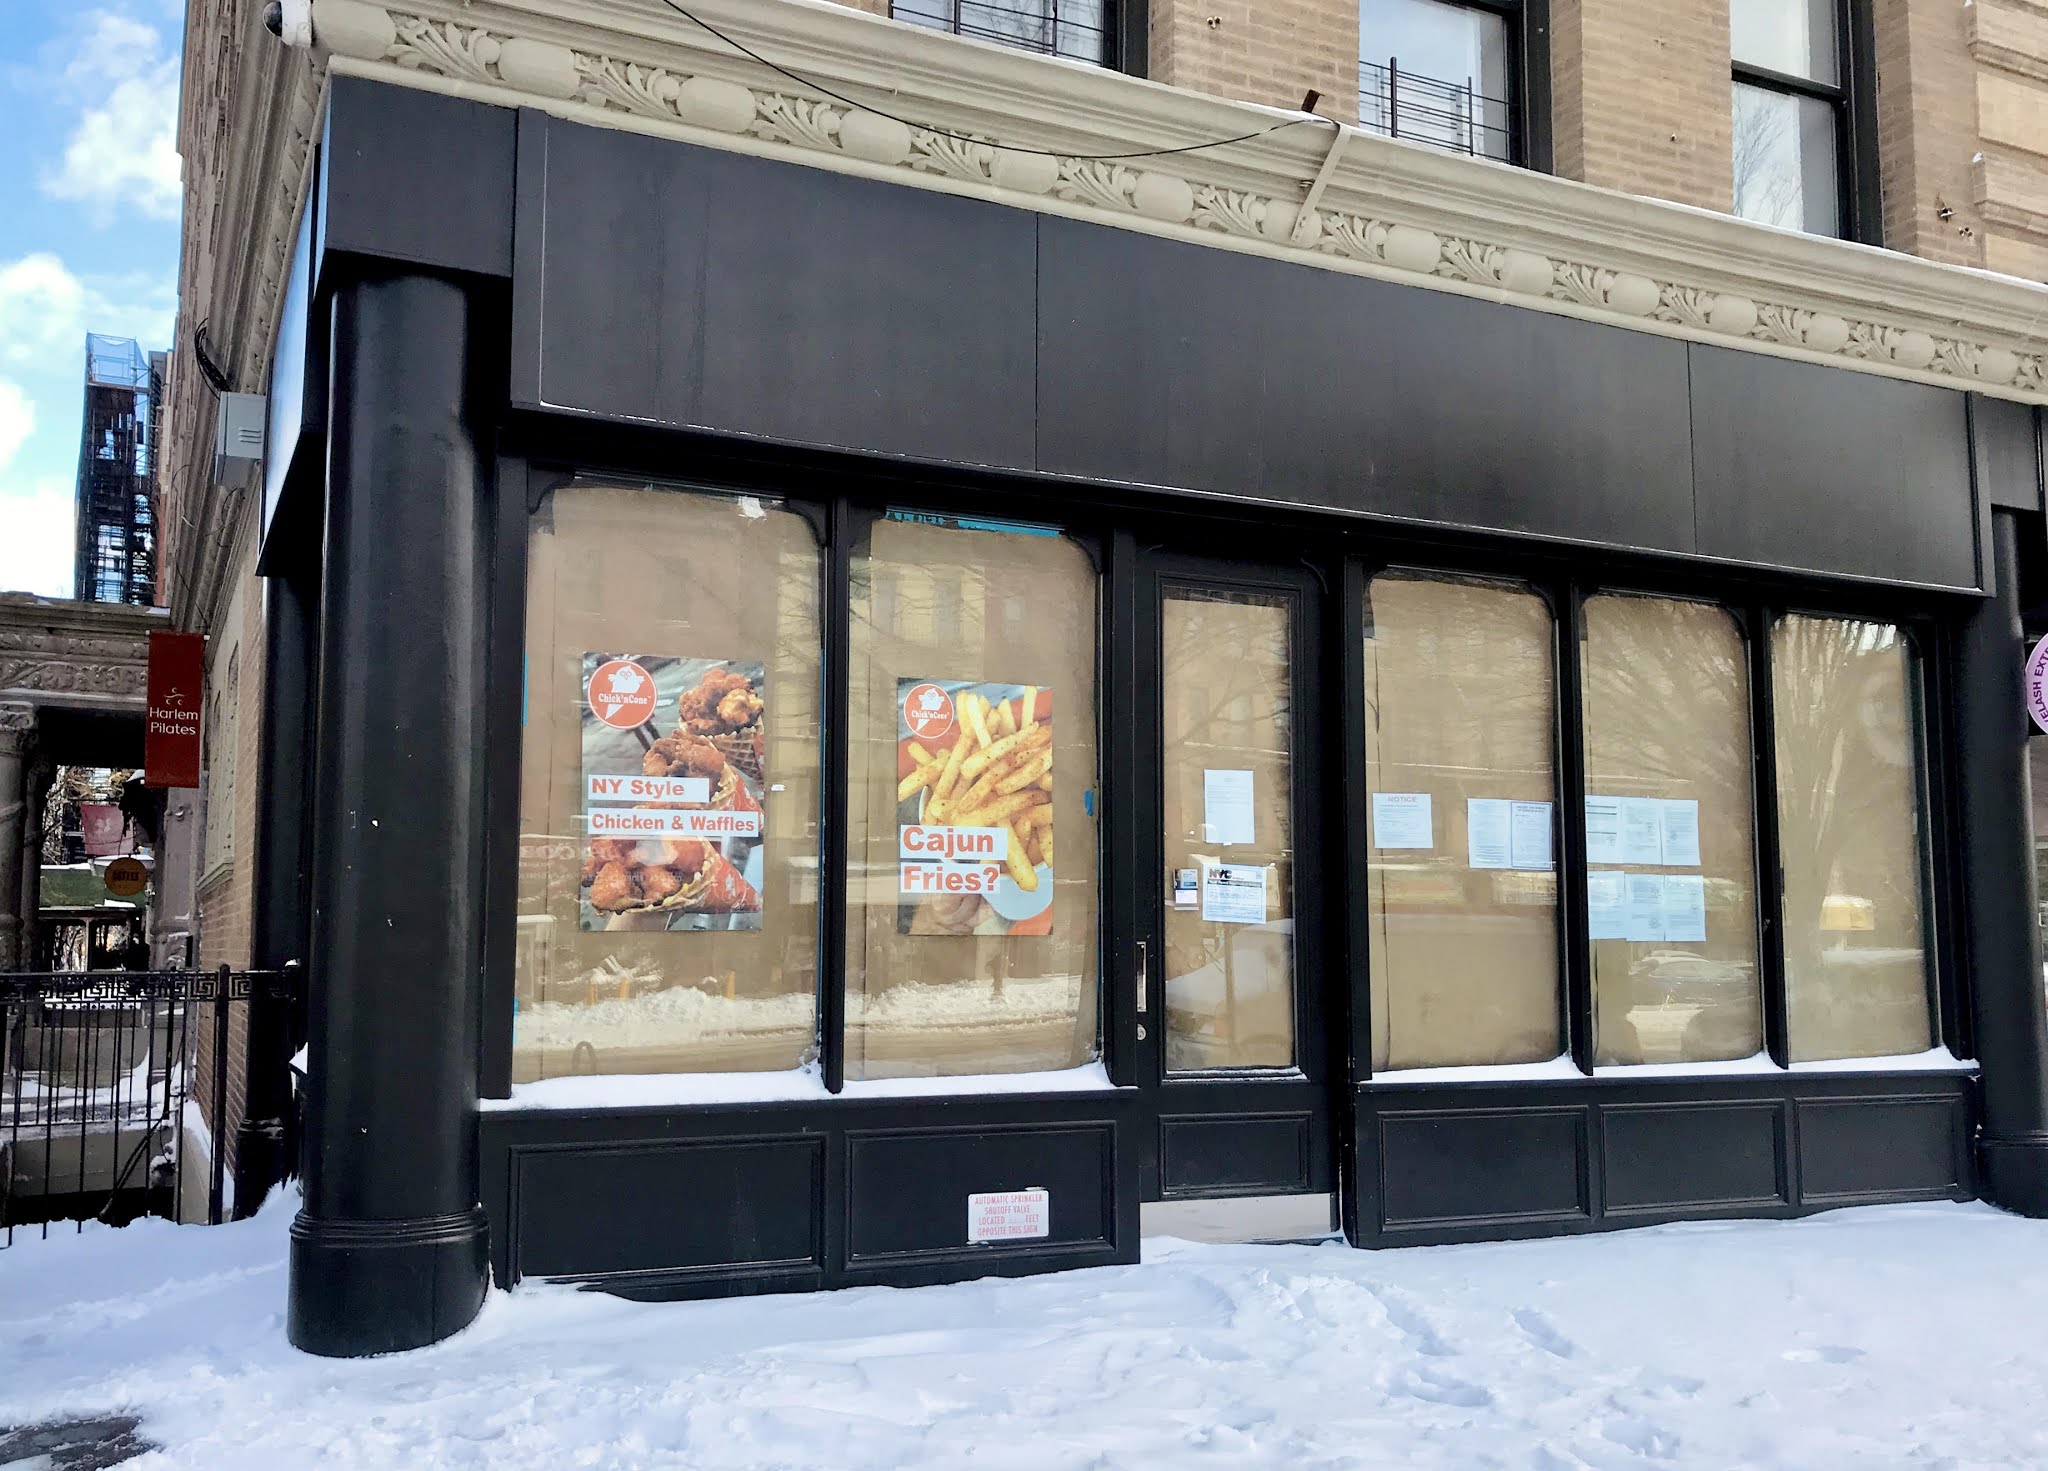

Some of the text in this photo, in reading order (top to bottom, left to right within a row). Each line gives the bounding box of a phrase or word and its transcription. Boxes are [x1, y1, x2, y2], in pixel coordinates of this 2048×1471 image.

[2033, 681, 2048, 722] ELASH
[149, 706, 199, 720] Harlem
[150, 721, 196, 735] Pilates
[592, 778, 685, 799] NY Style
[591, 813, 755, 831] Chicken & Waffles
[903, 826, 994, 858] Cajun
[903, 865, 999, 891] Fries?
[1209, 868, 1232, 879] NYC
[975, 1193, 1043, 1205] AUTOMATIC SPRINKLER
[985, 1204, 1030, 1215] SHUTOFF VALVE
[978, 1216, 1005, 1226] LOCATED
[1025, 1214, 1039, 1223] FEET
[977, 1224, 1038, 1236] OPPOSITE THIS SIGN
